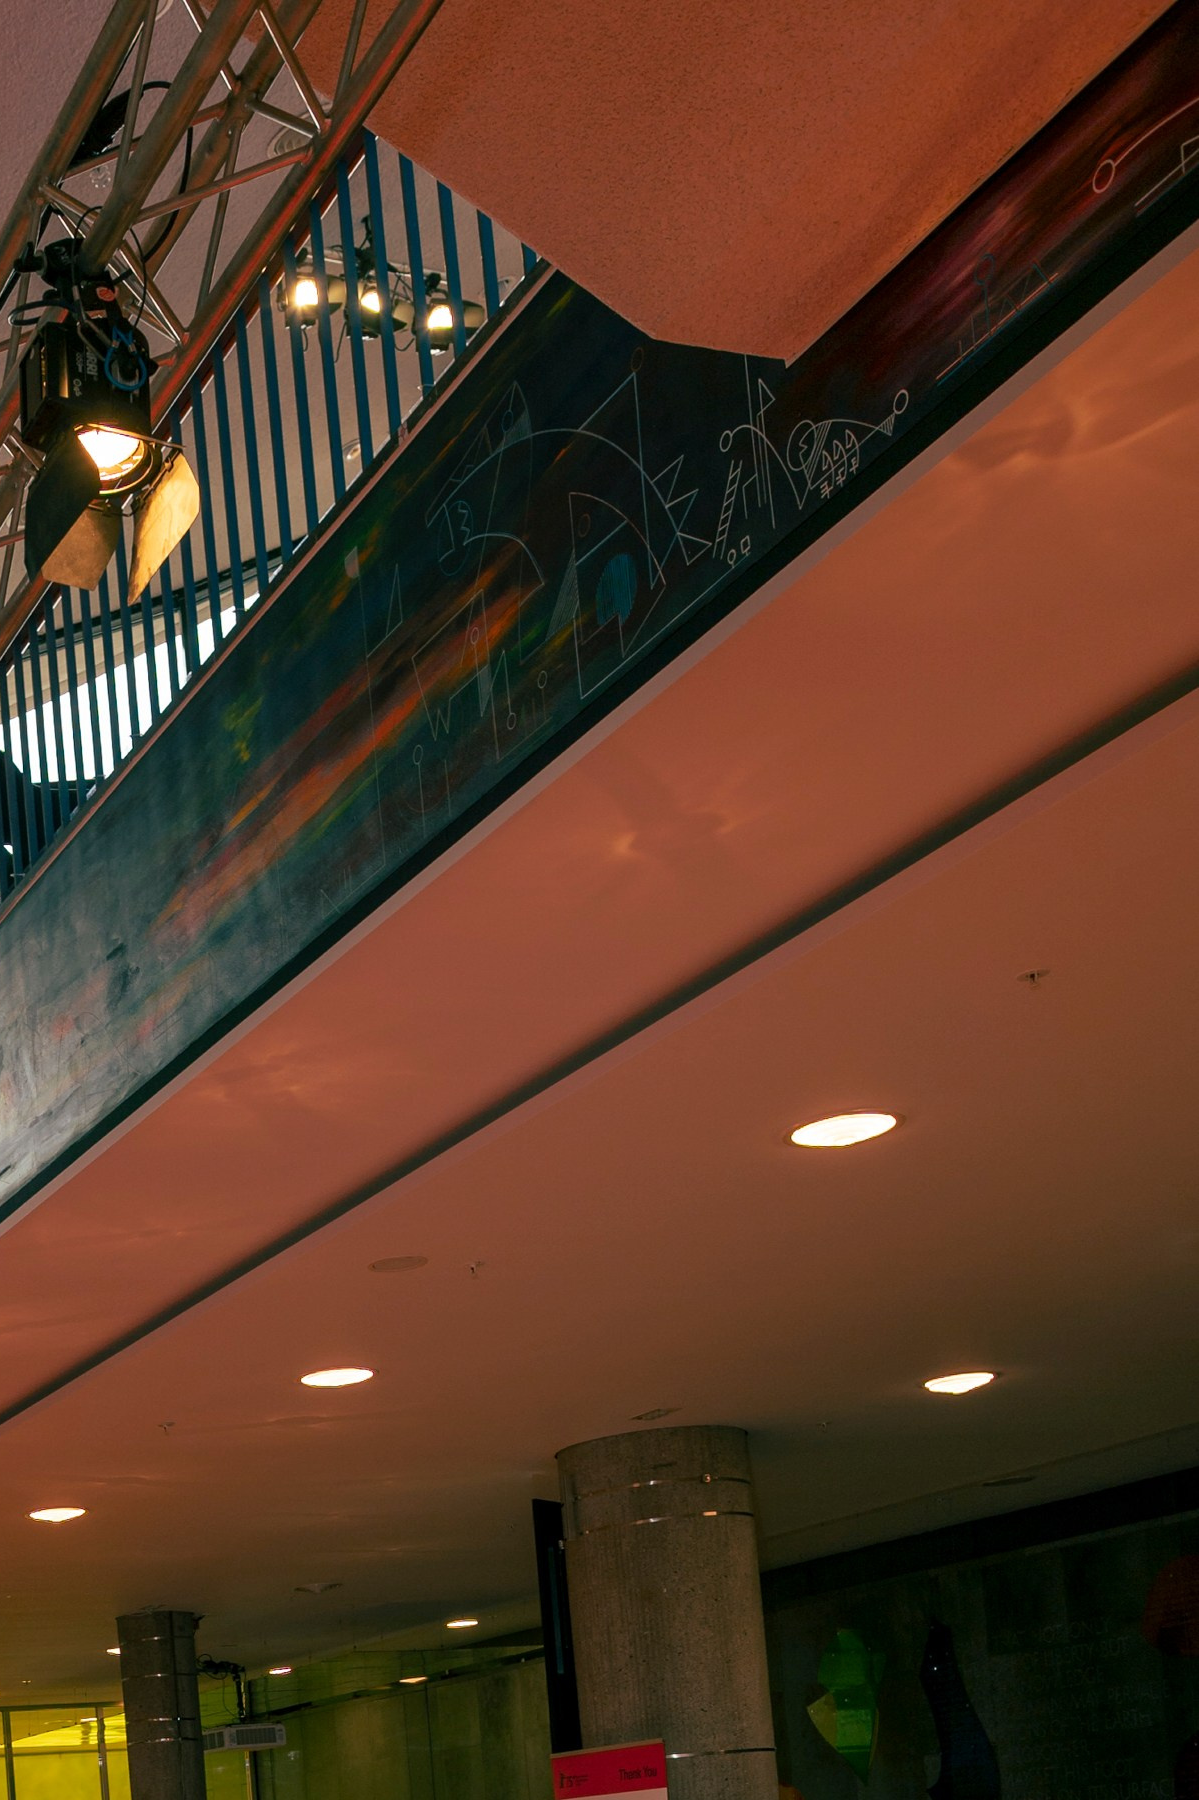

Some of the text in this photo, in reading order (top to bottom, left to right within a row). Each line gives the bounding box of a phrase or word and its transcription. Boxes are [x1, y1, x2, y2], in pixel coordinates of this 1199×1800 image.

[1069, 1615, 1111, 1640] ONLY
[1099, 1634, 1131, 1659] BUT
[1104, 1706, 1153, 1730] EARTH
[618, 1765, 658, 1782] Thank You
[1063, 1761, 1089, 1784] HIS
[1093, 1756, 1135, 1780] FOOT
